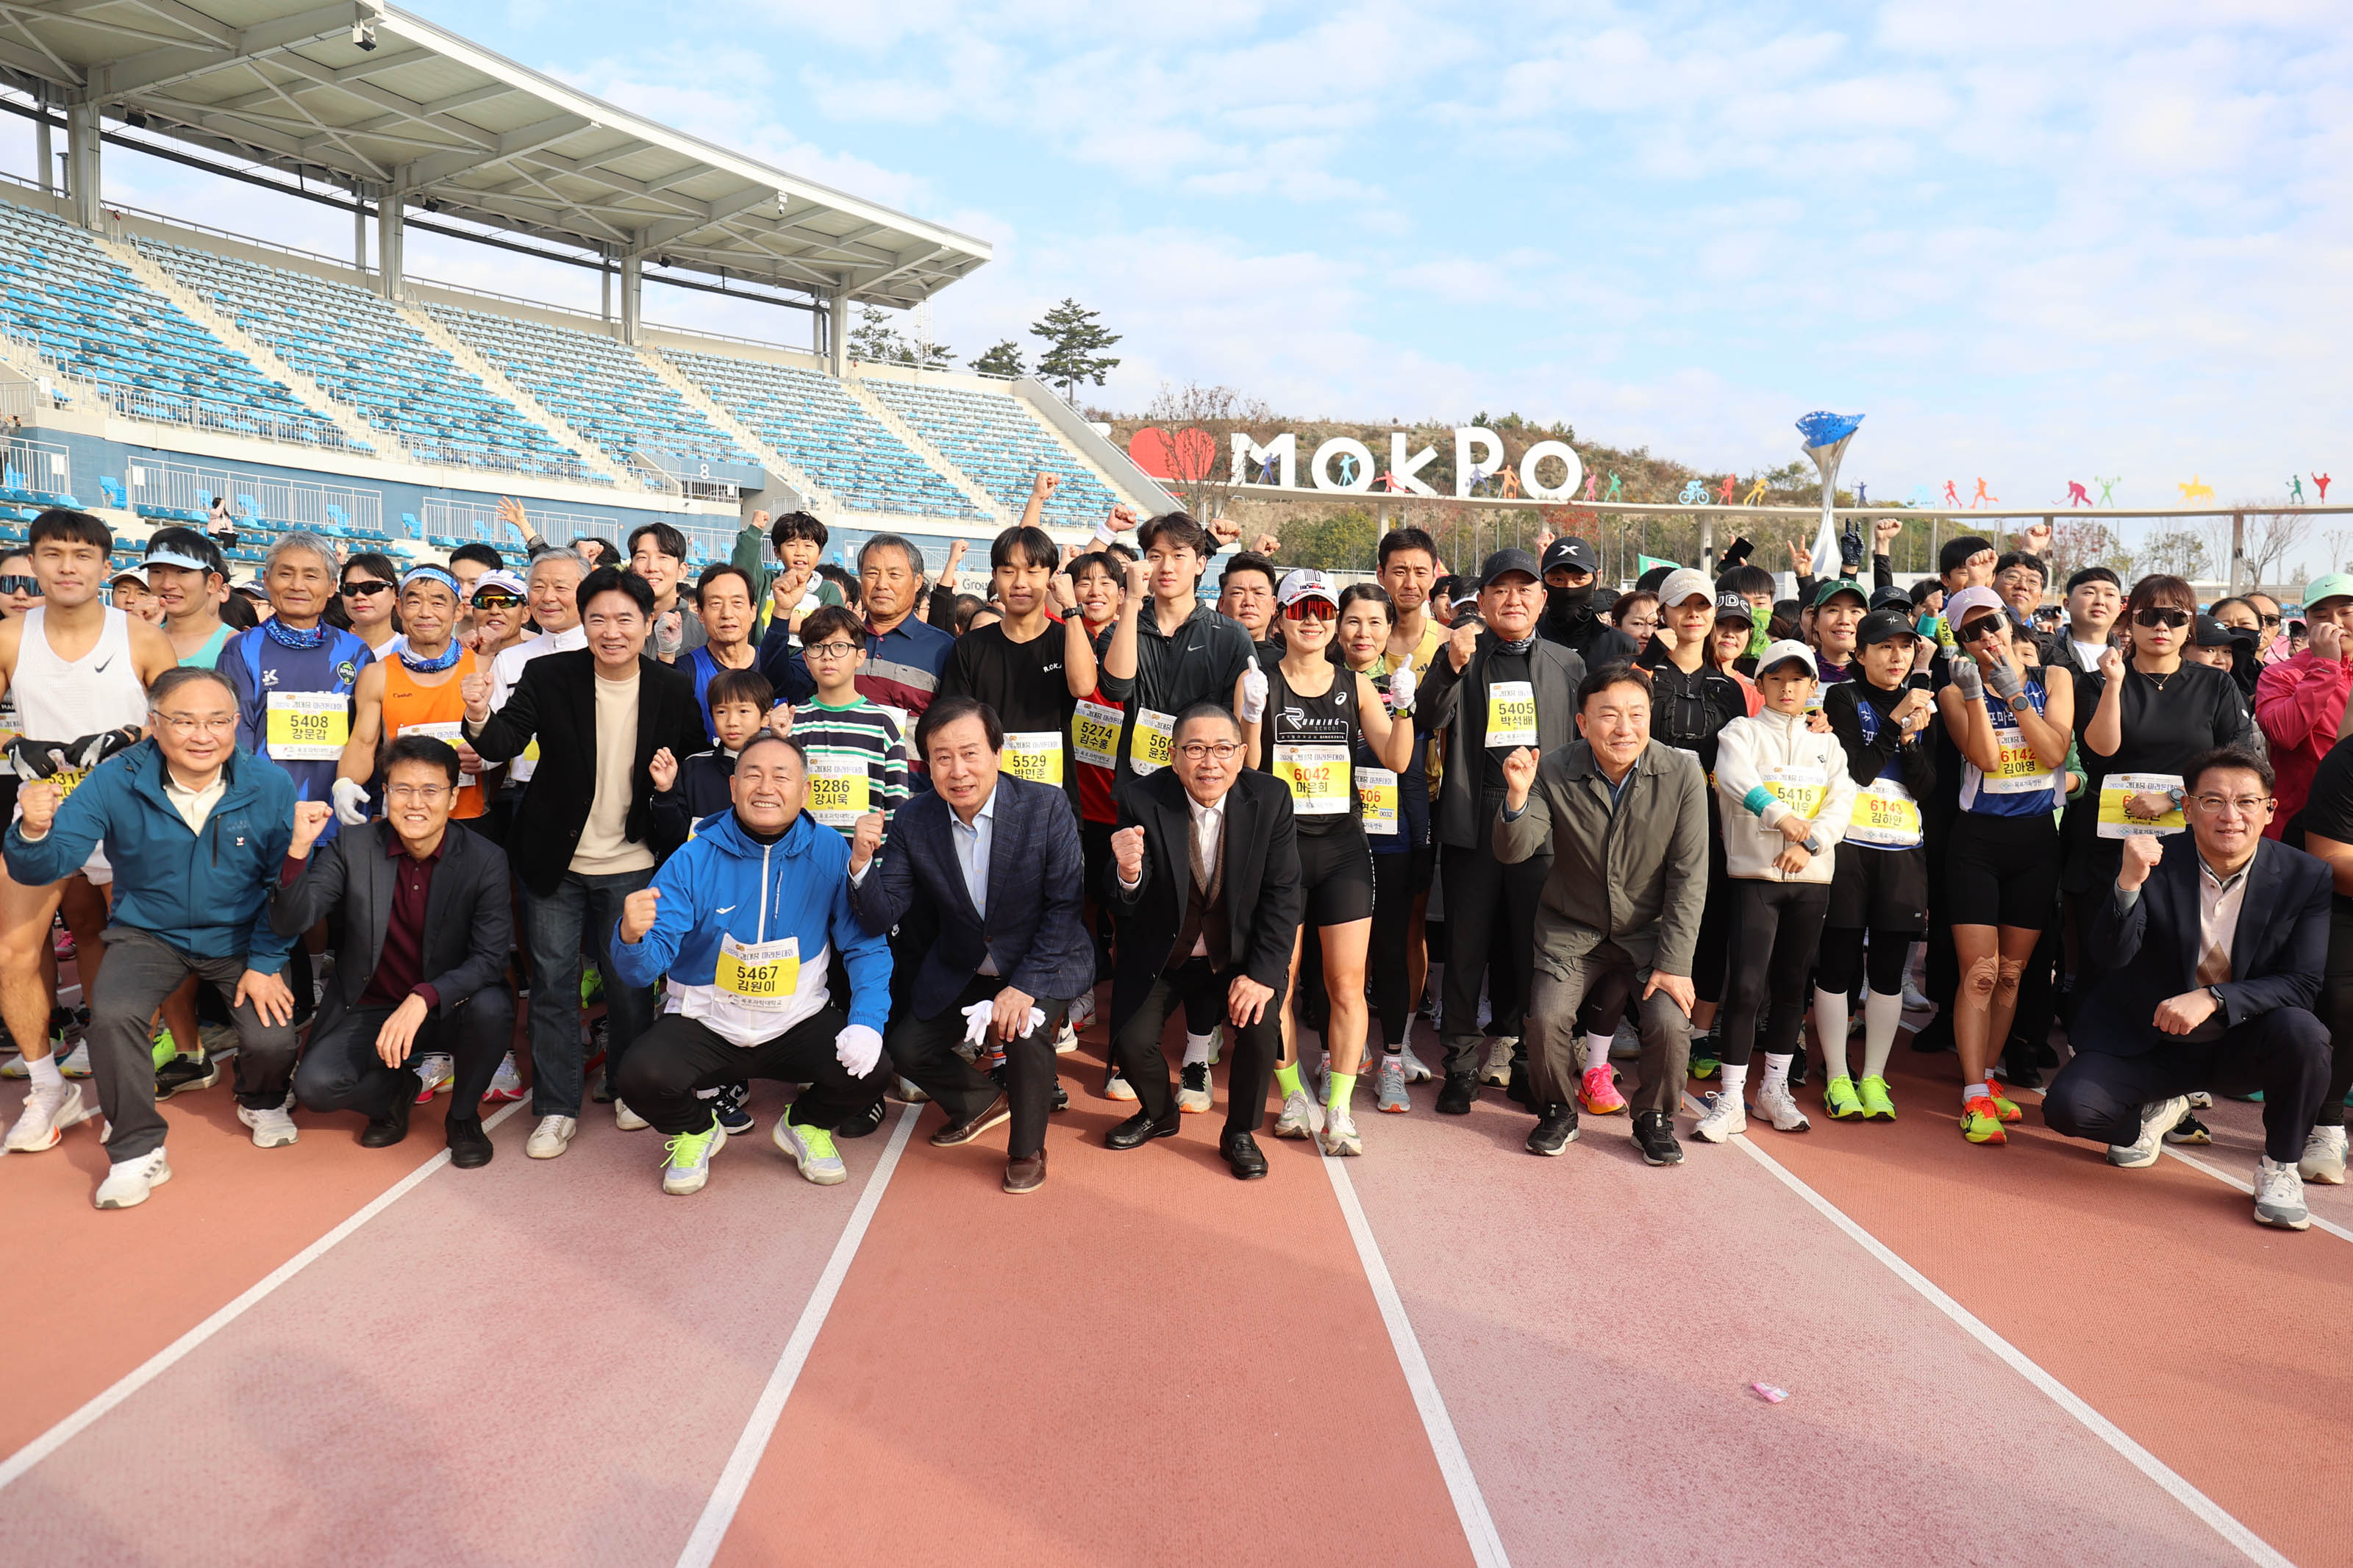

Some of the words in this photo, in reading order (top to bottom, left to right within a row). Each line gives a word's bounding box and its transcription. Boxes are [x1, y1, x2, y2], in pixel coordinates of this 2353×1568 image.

[700, 464, 710, 479] 8
[1499, 703, 1534, 715] 5405
[290, 715, 329, 728] 5408
[1284, 706, 1340, 730] RUNNING
[1501, 715, 1533, 726] 박석배
[291, 728, 327, 741] 강문갑
[1081, 722, 1113, 740] 5274
[1080, 734, 1109, 750] 김수홍
[1013, 755, 1046, 767] 5529
[2001, 748, 2036, 762] 6142
[2004, 760, 2035, 774] 김아영
[1014, 768, 1046, 780] 박민준
[1294, 767, 1329, 781] 6042
[813, 780, 850, 792] 5286
[1296, 781, 1327, 793] 마은희
[814, 793, 848, 806] 강시욱
[1777, 787, 1811, 801] 5416
[1780, 801, 1810, 813] 시우
[1871, 800, 1903, 815] 6143
[737, 965, 778, 980] 5467
[738, 980, 775, 992] 김원이
